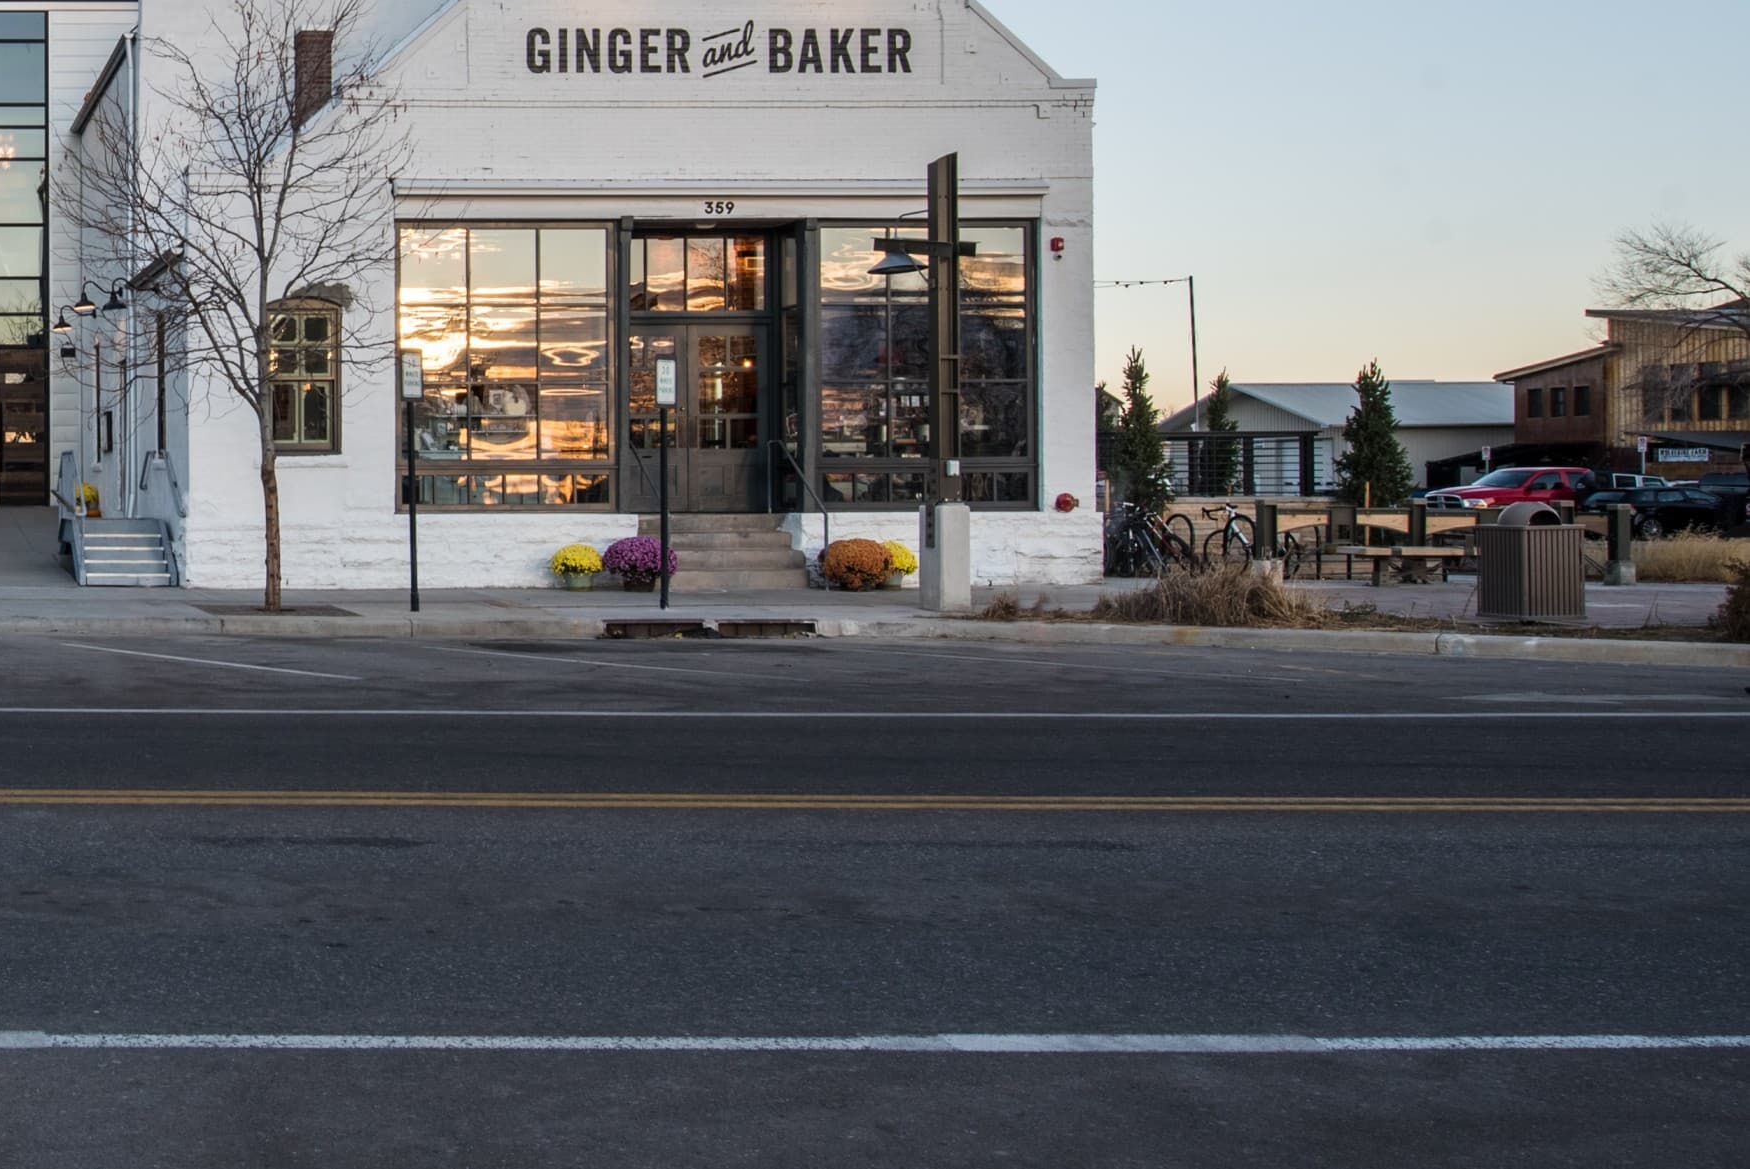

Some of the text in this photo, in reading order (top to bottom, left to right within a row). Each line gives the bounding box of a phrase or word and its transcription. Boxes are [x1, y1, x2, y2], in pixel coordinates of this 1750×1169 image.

[526, 19, 912, 74] GINGER and BAKER
[704, 201, 735, 215] 359
